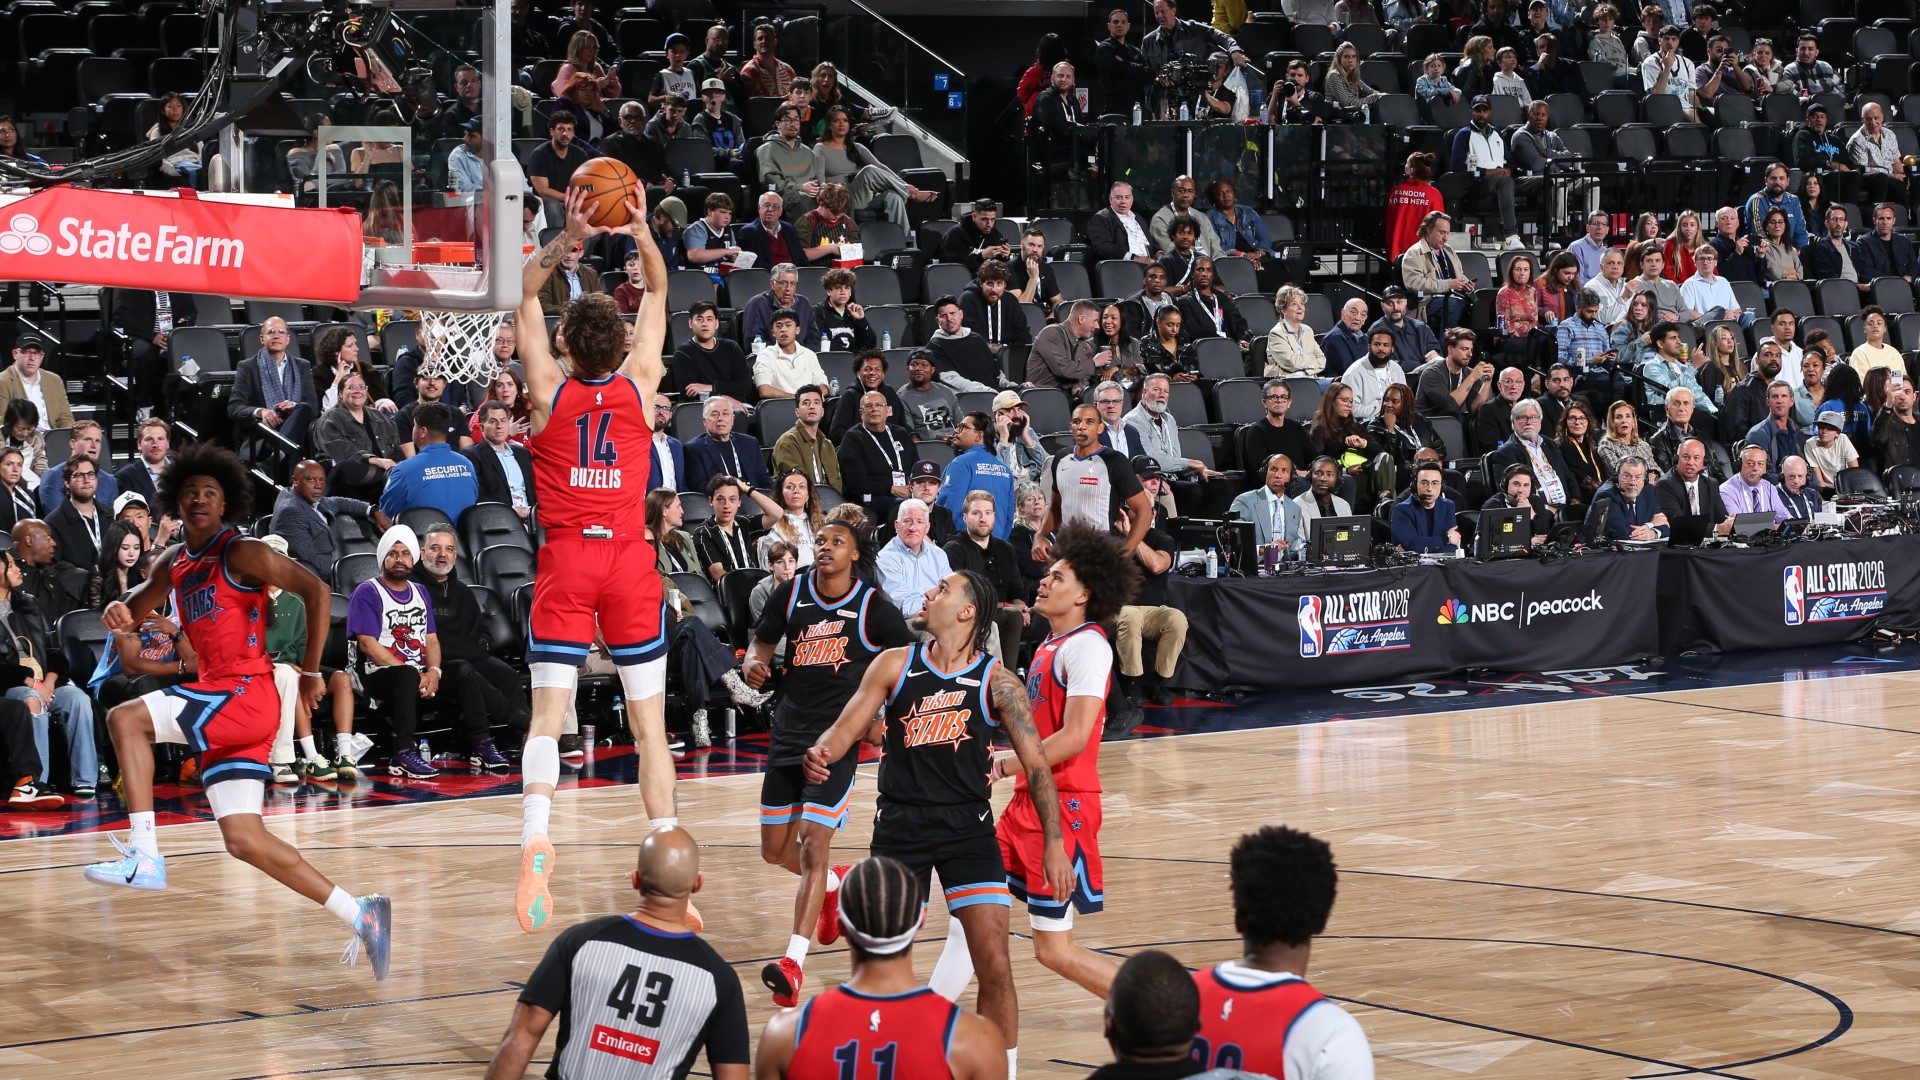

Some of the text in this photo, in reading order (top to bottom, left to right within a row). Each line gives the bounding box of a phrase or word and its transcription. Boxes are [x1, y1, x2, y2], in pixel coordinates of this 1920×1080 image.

[1410, 198, 1430, 206] HERE
[56, 217, 244, 268] State Farm
[576, 412, 617, 468] 14
[422, 474, 445, 482] FANDOM
[424, 464, 467, 476] SECURITY
[569, 467, 621, 489] BUZELIS
[976, 462, 1007, 472] SECURITY
[1806, 560, 1886, 594] ALL STAR 2026
[1324, 588, 1410, 624] ALL STAR 2026
[1471, 589, 1604, 625] NBC peacock
[1833, 596, 1884, 615] Los Angeles
[804, 620, 846, 638] RISING
[1354, 626, 1406, 647] Los Angeles
[792, 636, 849, 666] STARS
[1303, 642, 1315, 654] NBA
[918, 690, 967, 712] RISING
[1331, 682, 1469, 703] 26
[904, 708, 972, 748] STARS
[606, 963, 674, 1028] 43
[597, 1031, 652, 1057] Emirates
[833, 1039, 898, 1080] 11
